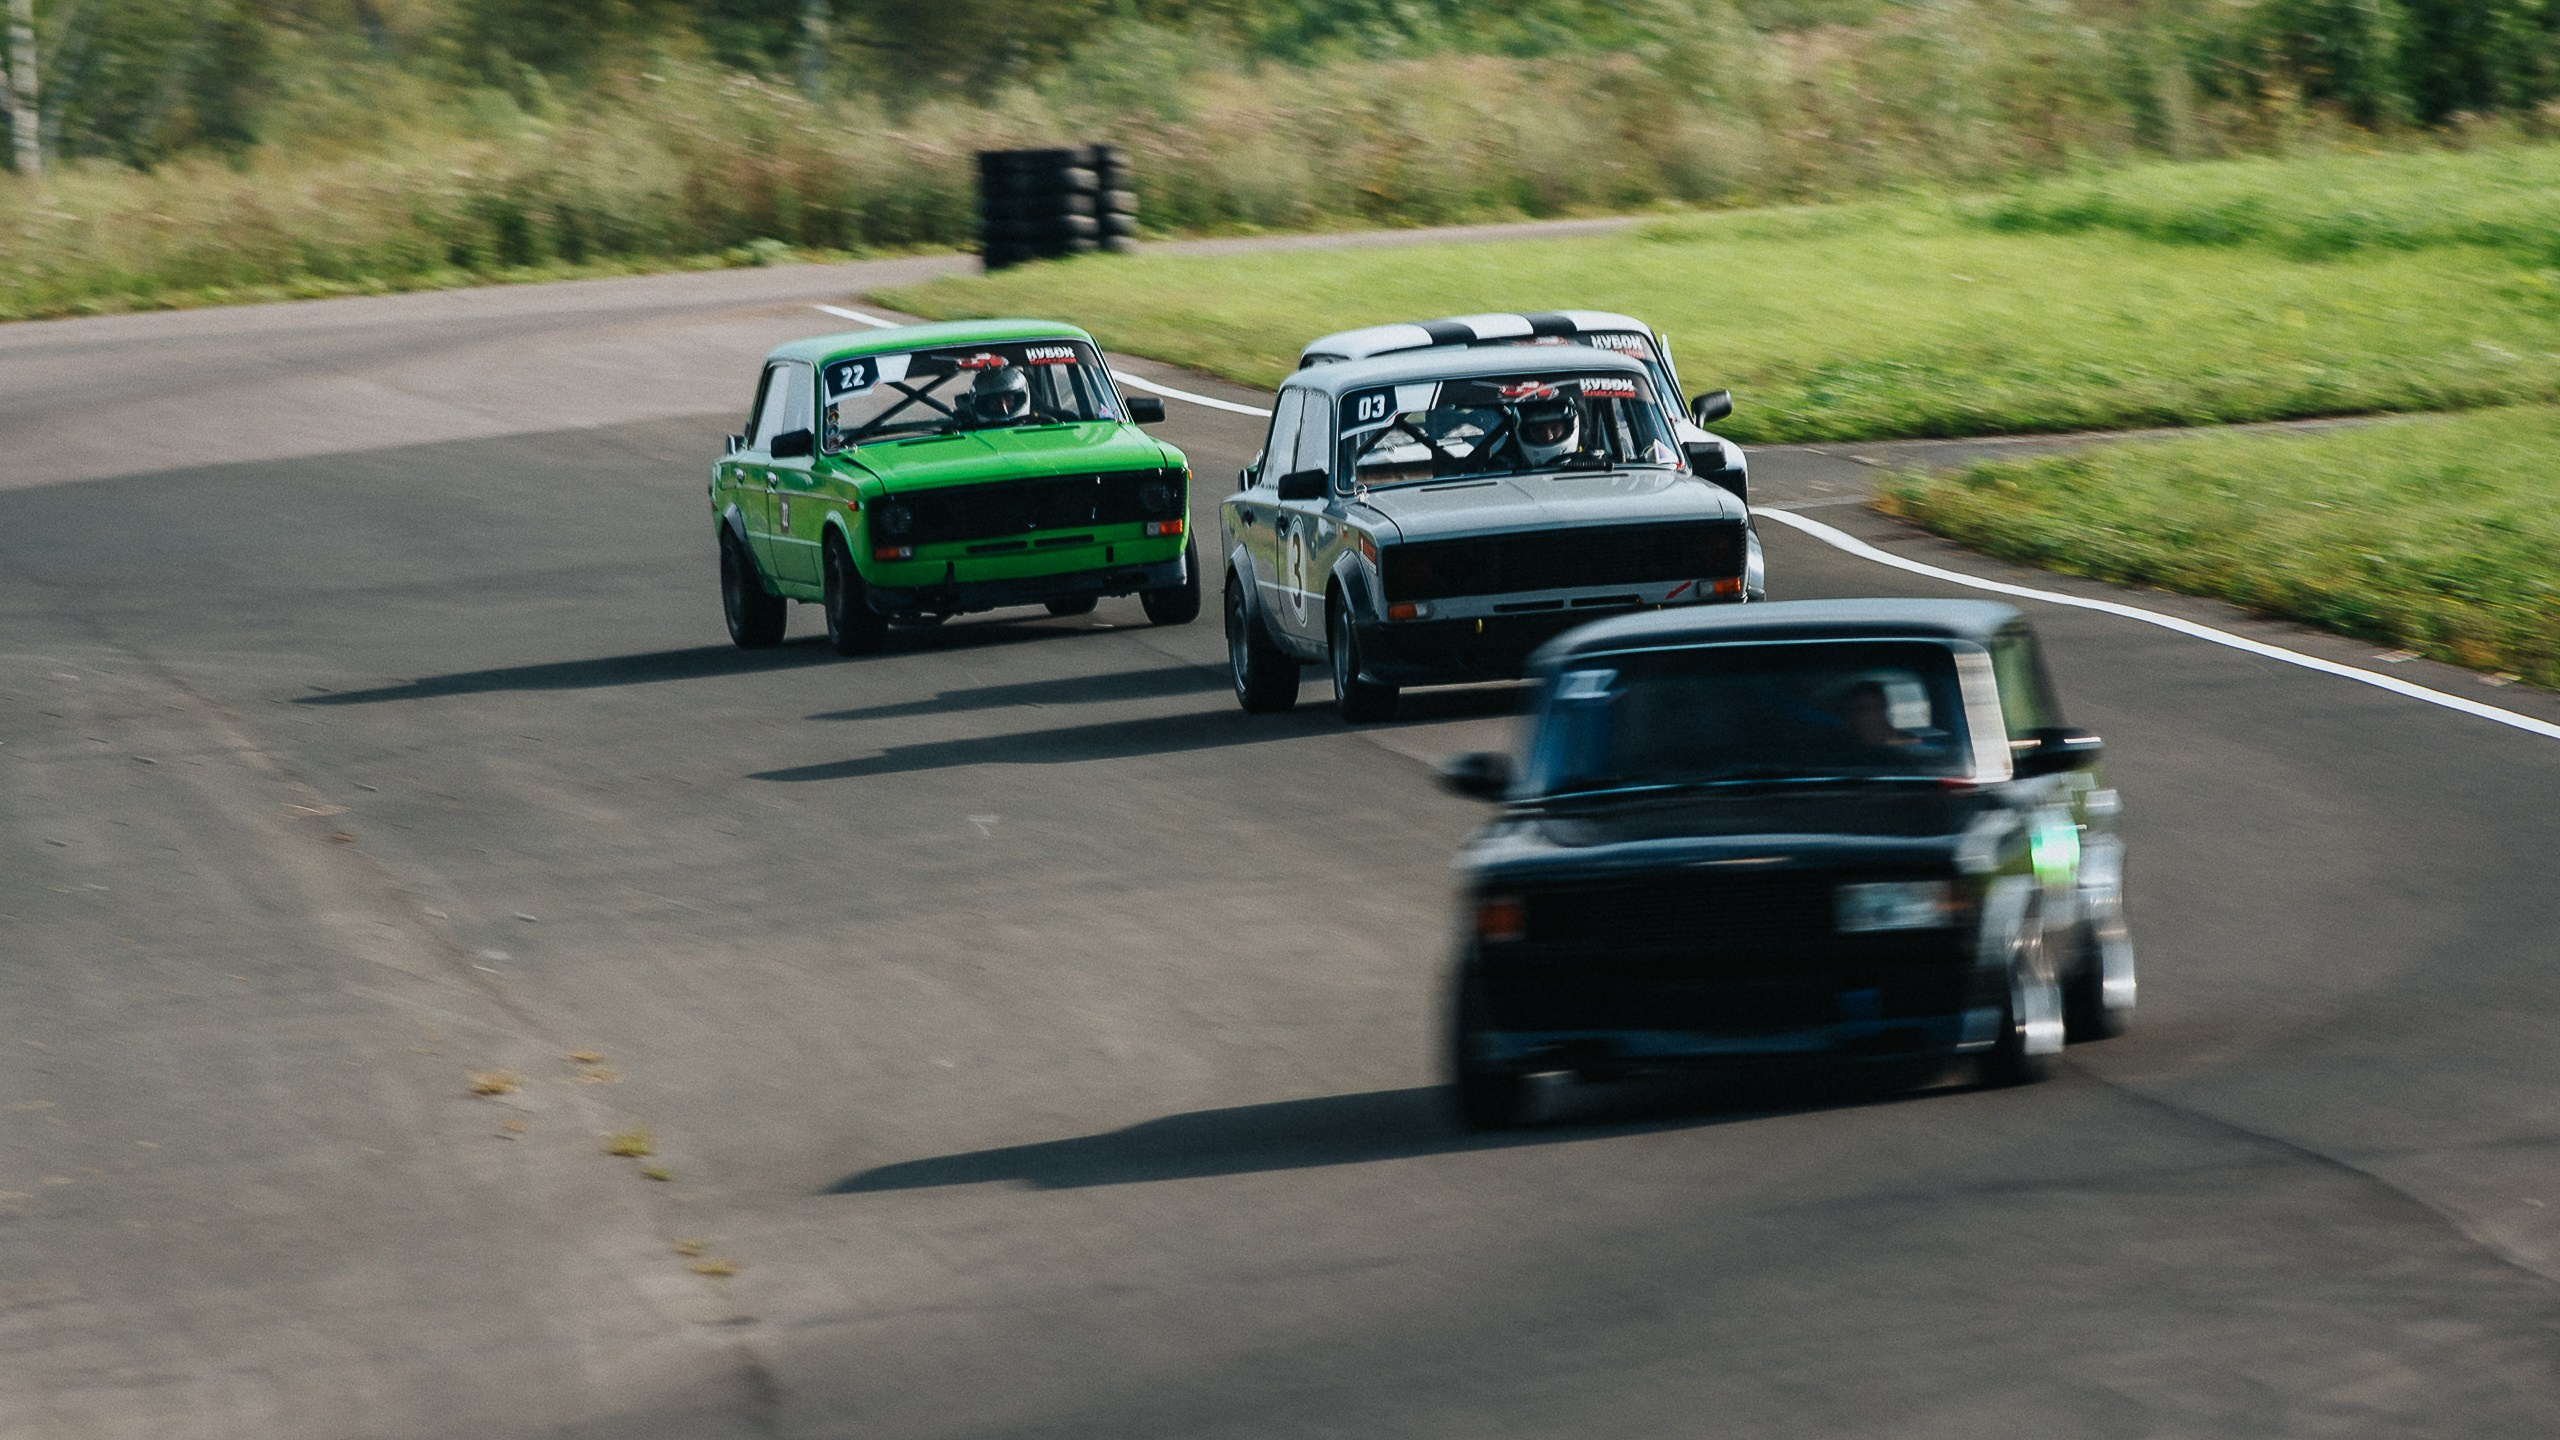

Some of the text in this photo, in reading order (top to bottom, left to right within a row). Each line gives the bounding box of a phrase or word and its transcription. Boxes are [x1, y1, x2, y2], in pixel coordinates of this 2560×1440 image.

[840, 364, 865, 390] 22
[1358, 394, 1386, 421] 03
[1292, 532, 1303, 609] 3
